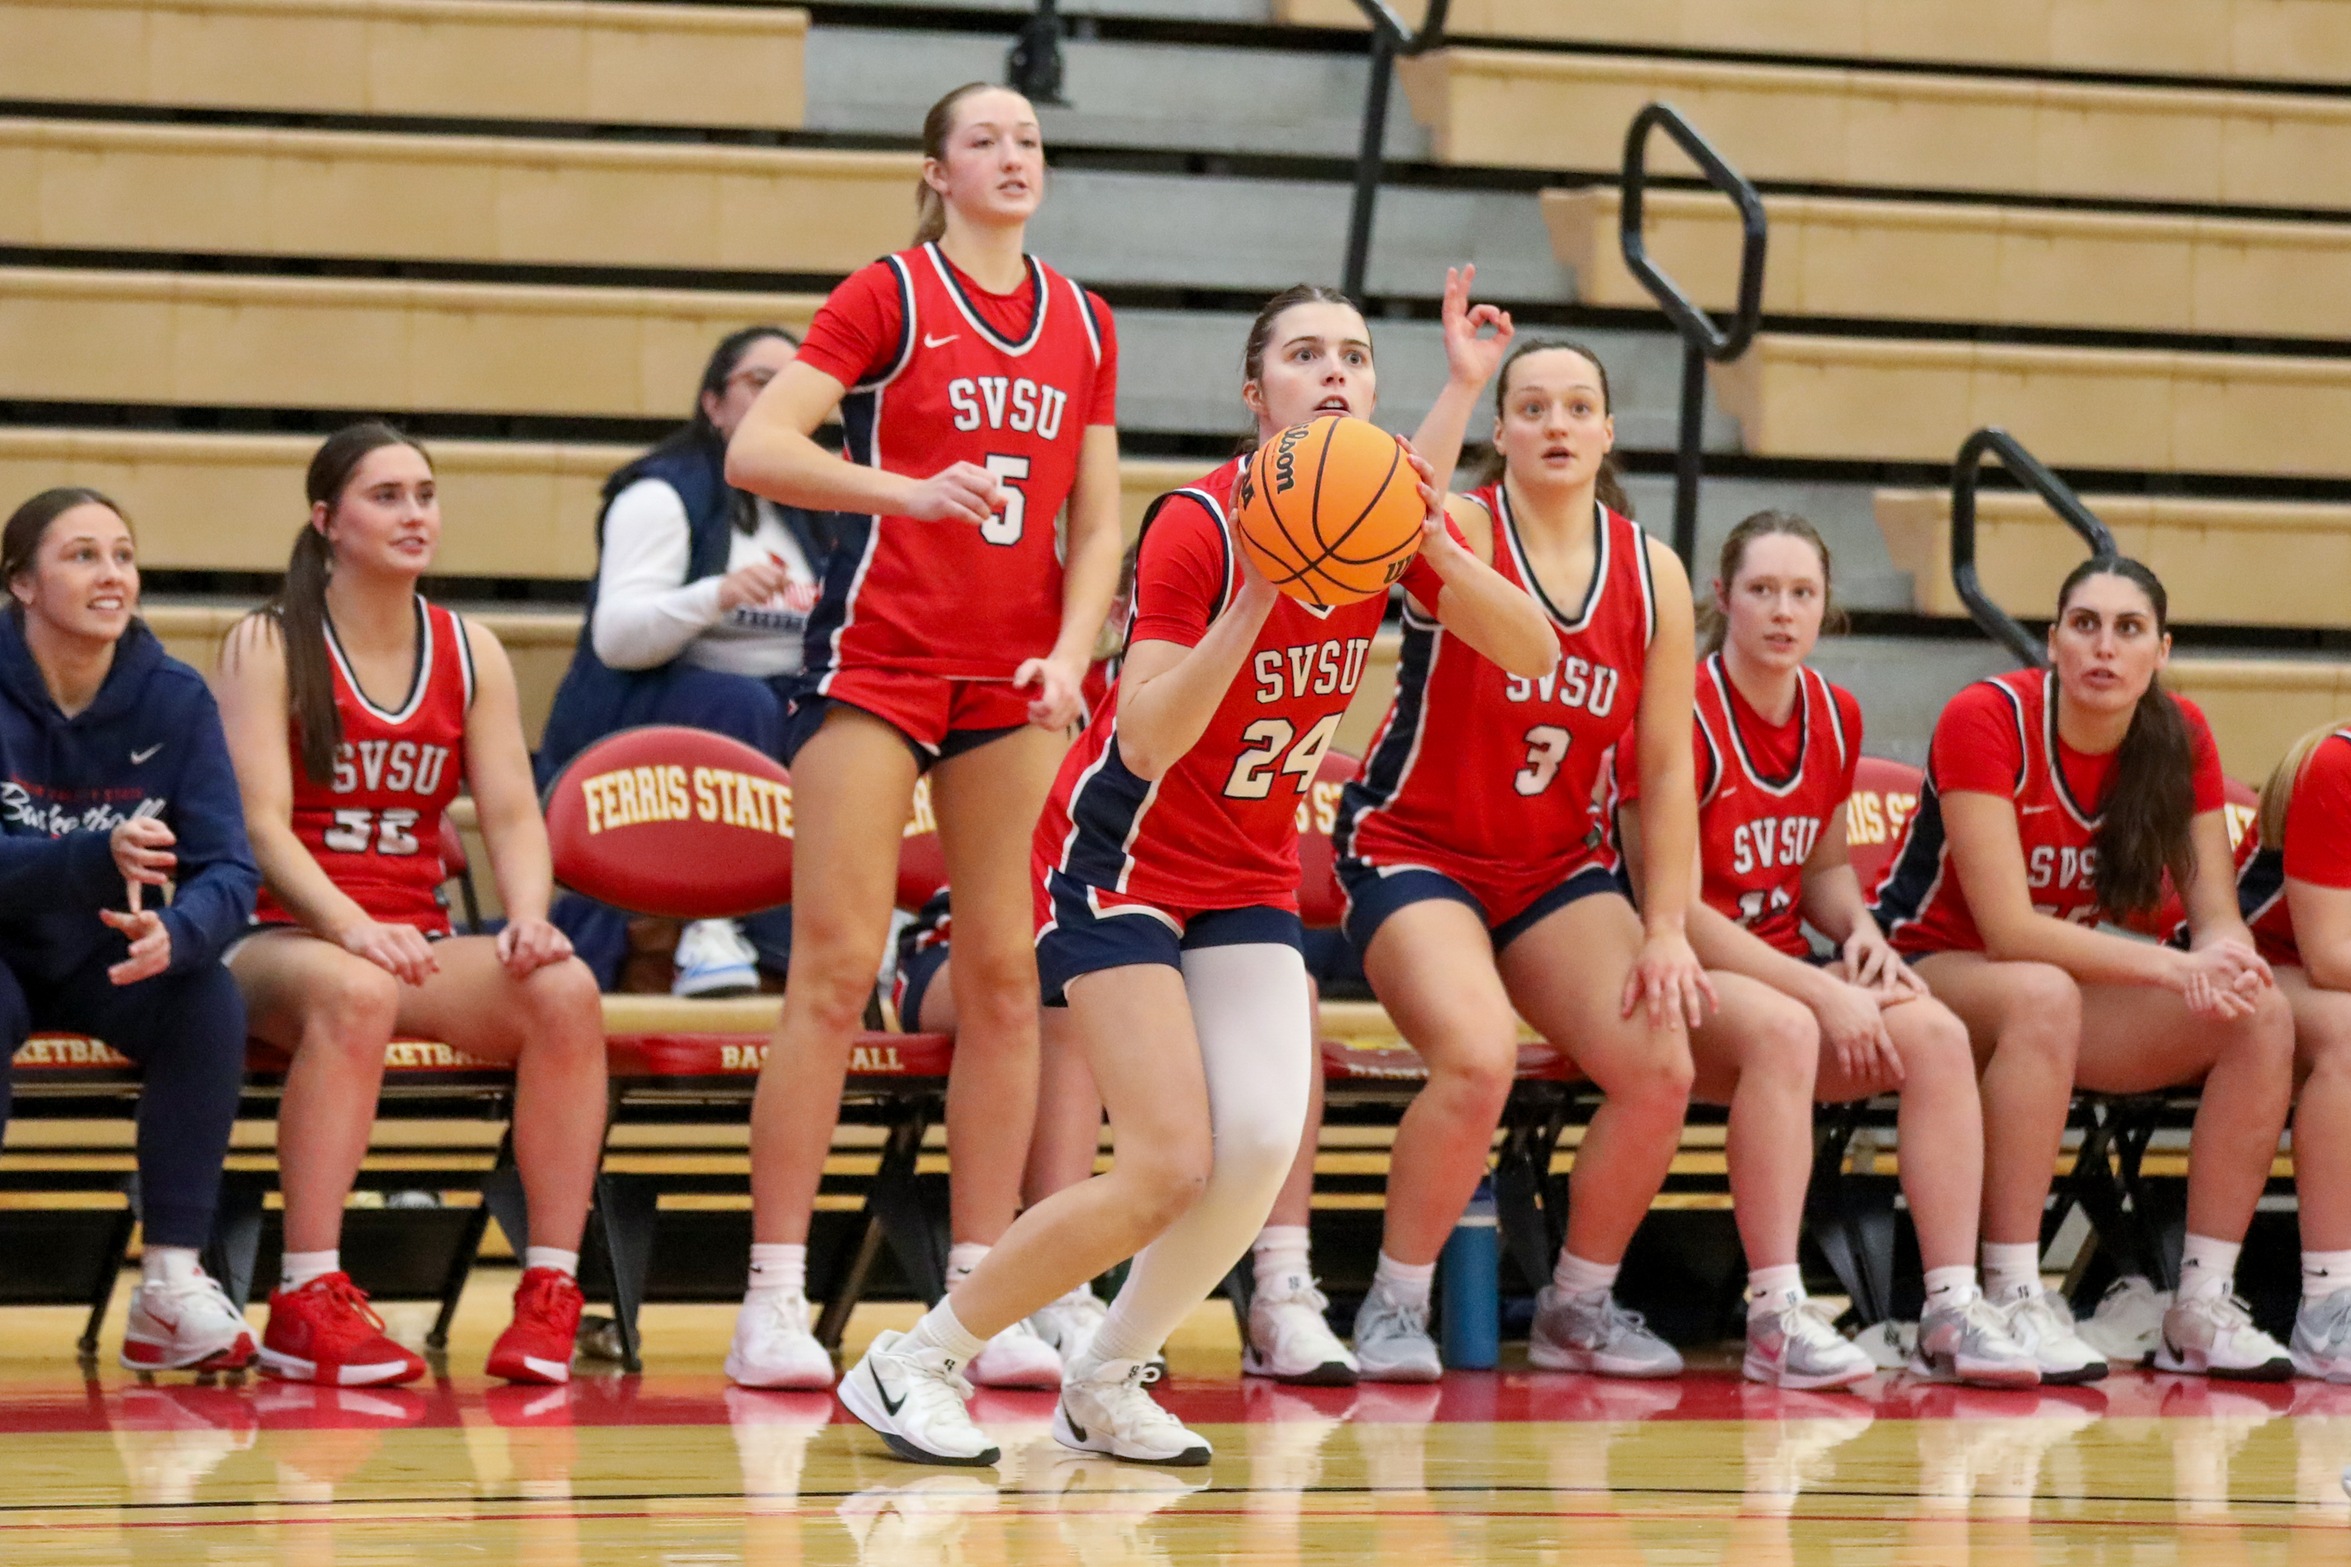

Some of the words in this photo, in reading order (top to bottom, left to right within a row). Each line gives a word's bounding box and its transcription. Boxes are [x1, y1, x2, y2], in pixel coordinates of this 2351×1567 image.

[948, 376, 1067, 441] SVSU
[980, 453, 1031, 547] 5
[1253, 637, 1371, 705] SVSU
[332, 740, 449, 796] SVSU
[1222, 709, 1345, 799] 24
[1513, 723, 1572, 796] 3
[581, 765, 690, 834] FERRIS
[693, 766, 794, 840] STATE
[1733, 816, 1820, 875] SVSU
[2027, 845, 2098, 891] SVS
